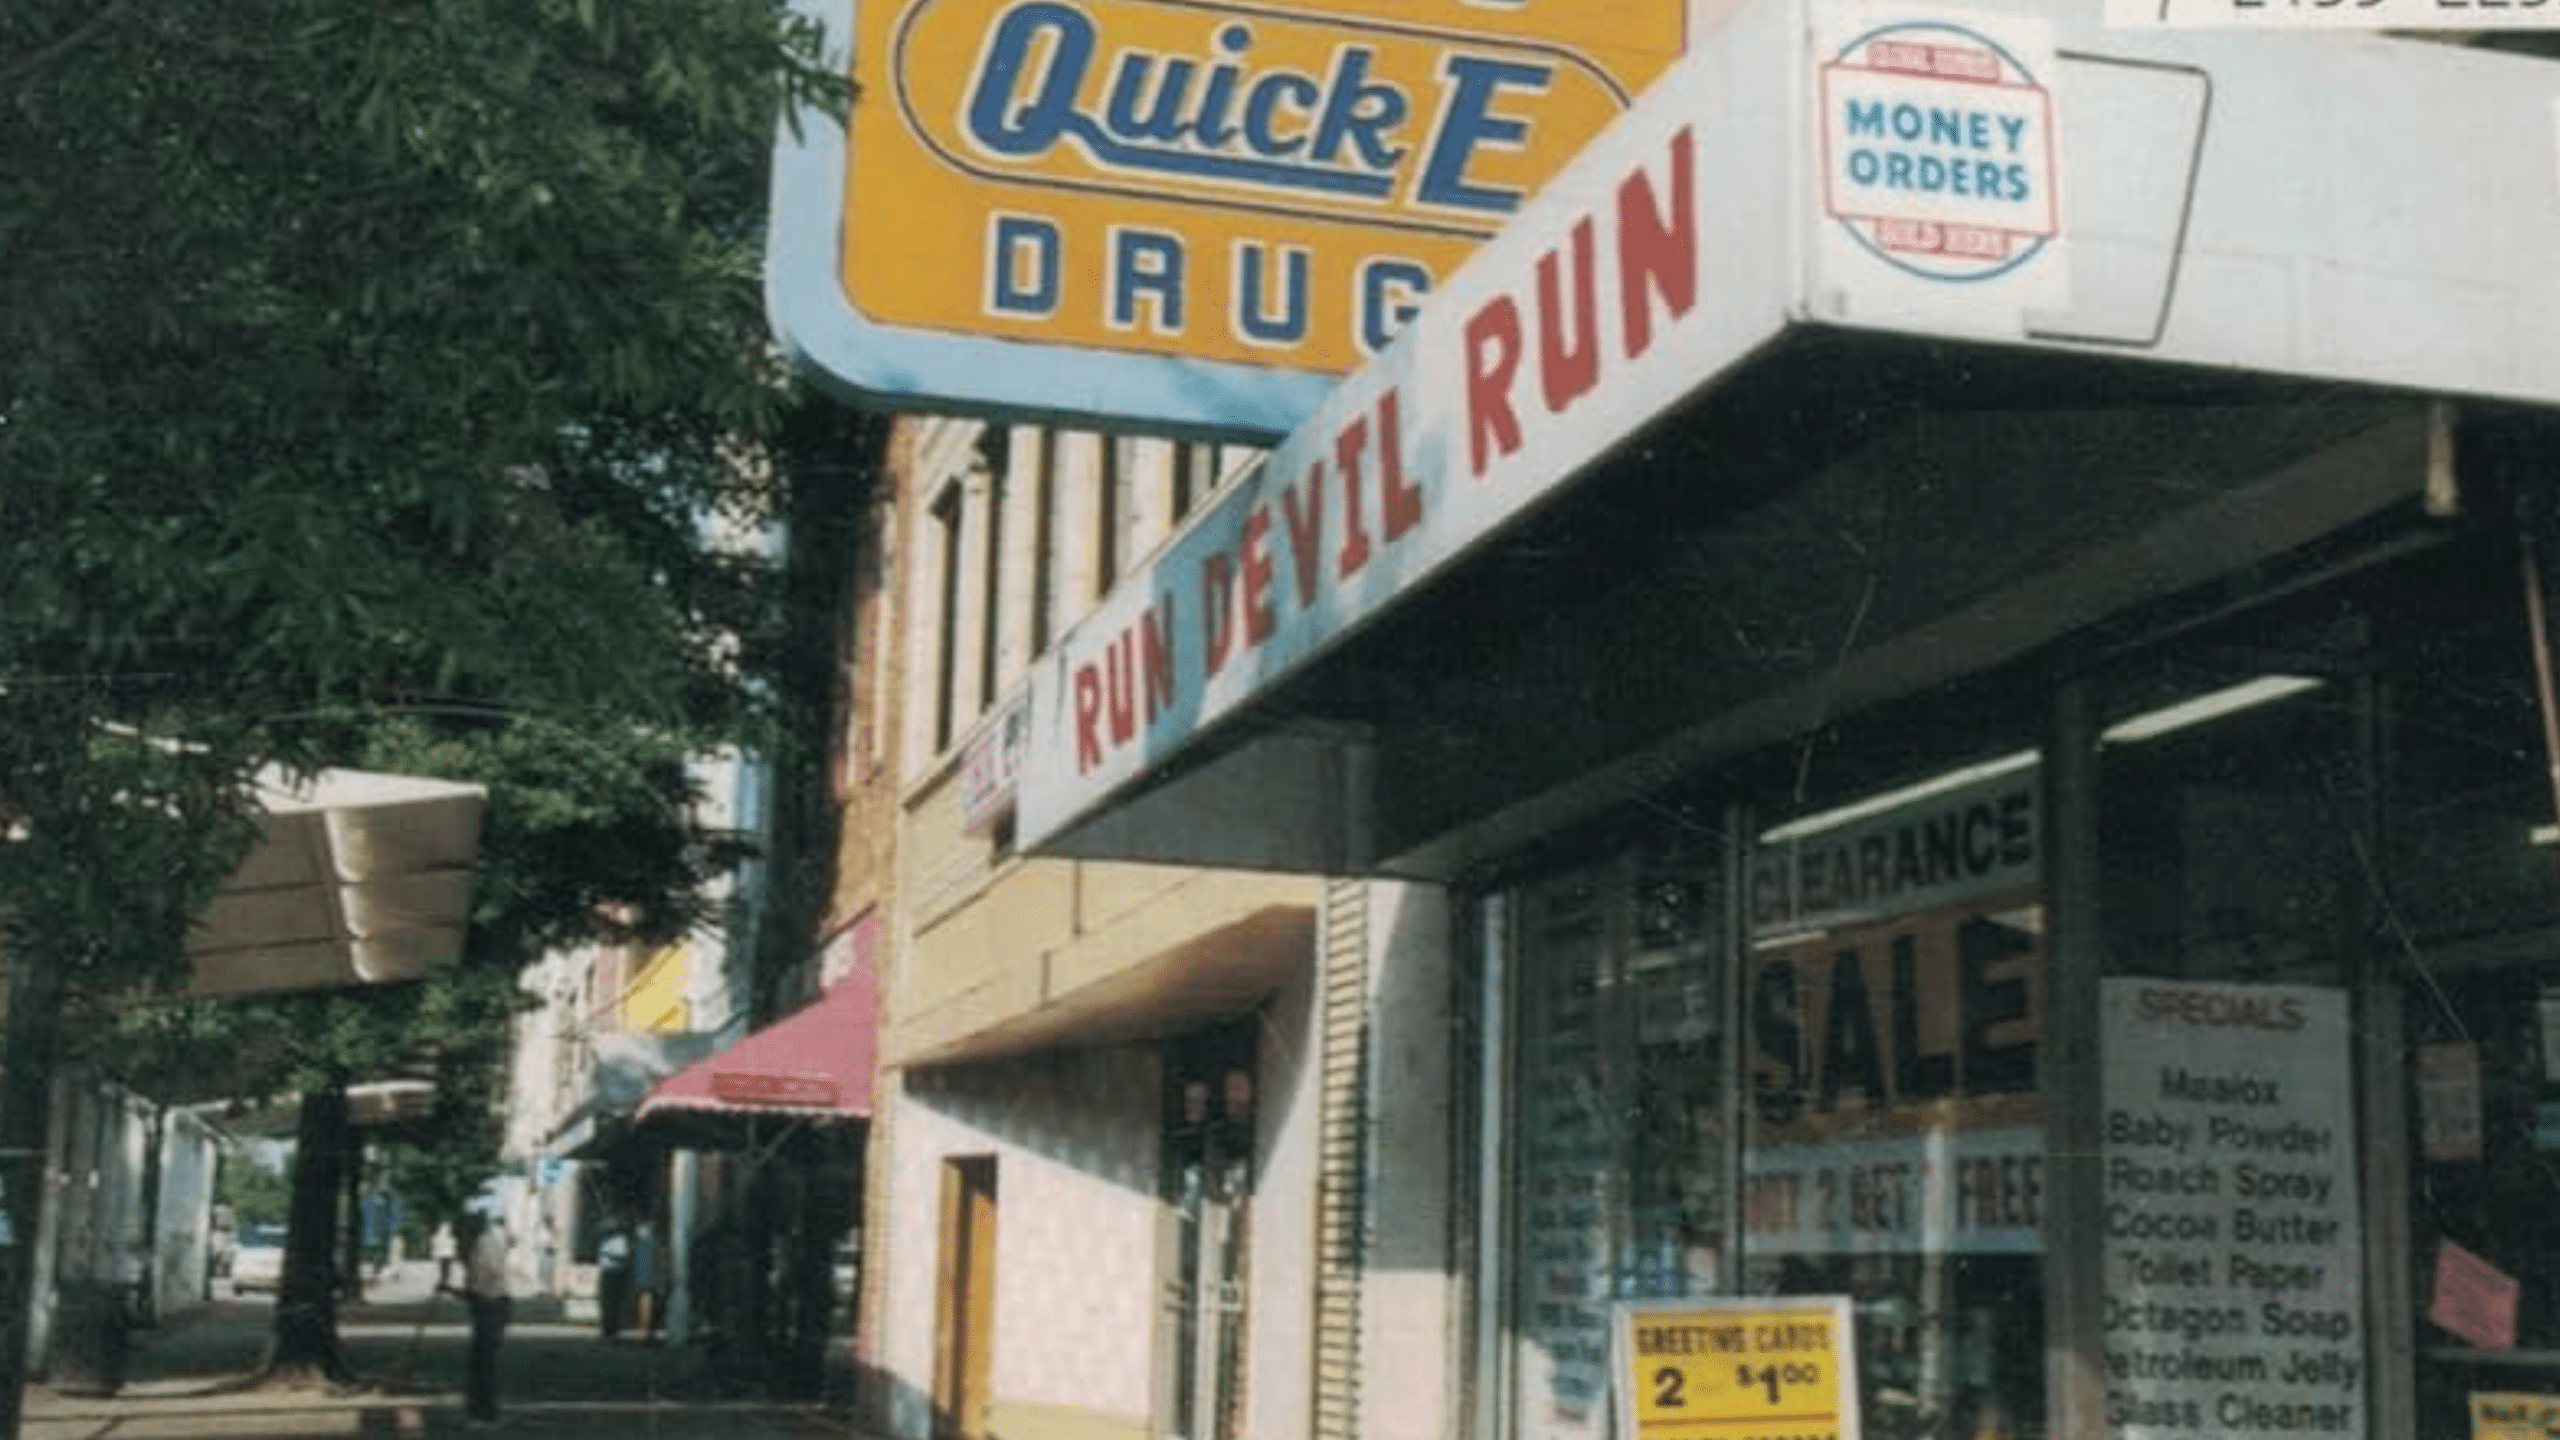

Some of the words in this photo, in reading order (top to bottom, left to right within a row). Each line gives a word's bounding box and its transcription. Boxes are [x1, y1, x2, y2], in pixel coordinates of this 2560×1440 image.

[968, 3, 1405, 196] Quick
[1417, 55, 1553, 212] E
[1846, 99, 2026, 153] MONEY
[1849, 149, 2029, 202] ORDERS
[1073, 589, 1176, 776] RUN
[1202, 386, 1423, 677] DEVIL
[1463, 123, 1697, 477] RUN
[1751, 789, 2033, 925] CLEARANCE
[1752, 912, 2038, 1126] SALE
[2137, 989, 2306, 1031] SPECIALS
[2108, 1111, 2192, 1153] Baby
[2208, 1116, 2331, 1154] Powder
[1956, 1155, 2042, 1230] FREE
[2234, 1161, 2334, 1206] Spray
[2106, 1202, 2216, 1239] Cocoa
[2234, 1208, 2338, 1244] Butter
[2229, 1253, 2325, 1296] Paper
[2261, 1302, 2349, 1343] Soap
[1653, 1365, 1687, 1408] 2
[2218, 1391, 2351, 1431] Cleaner
